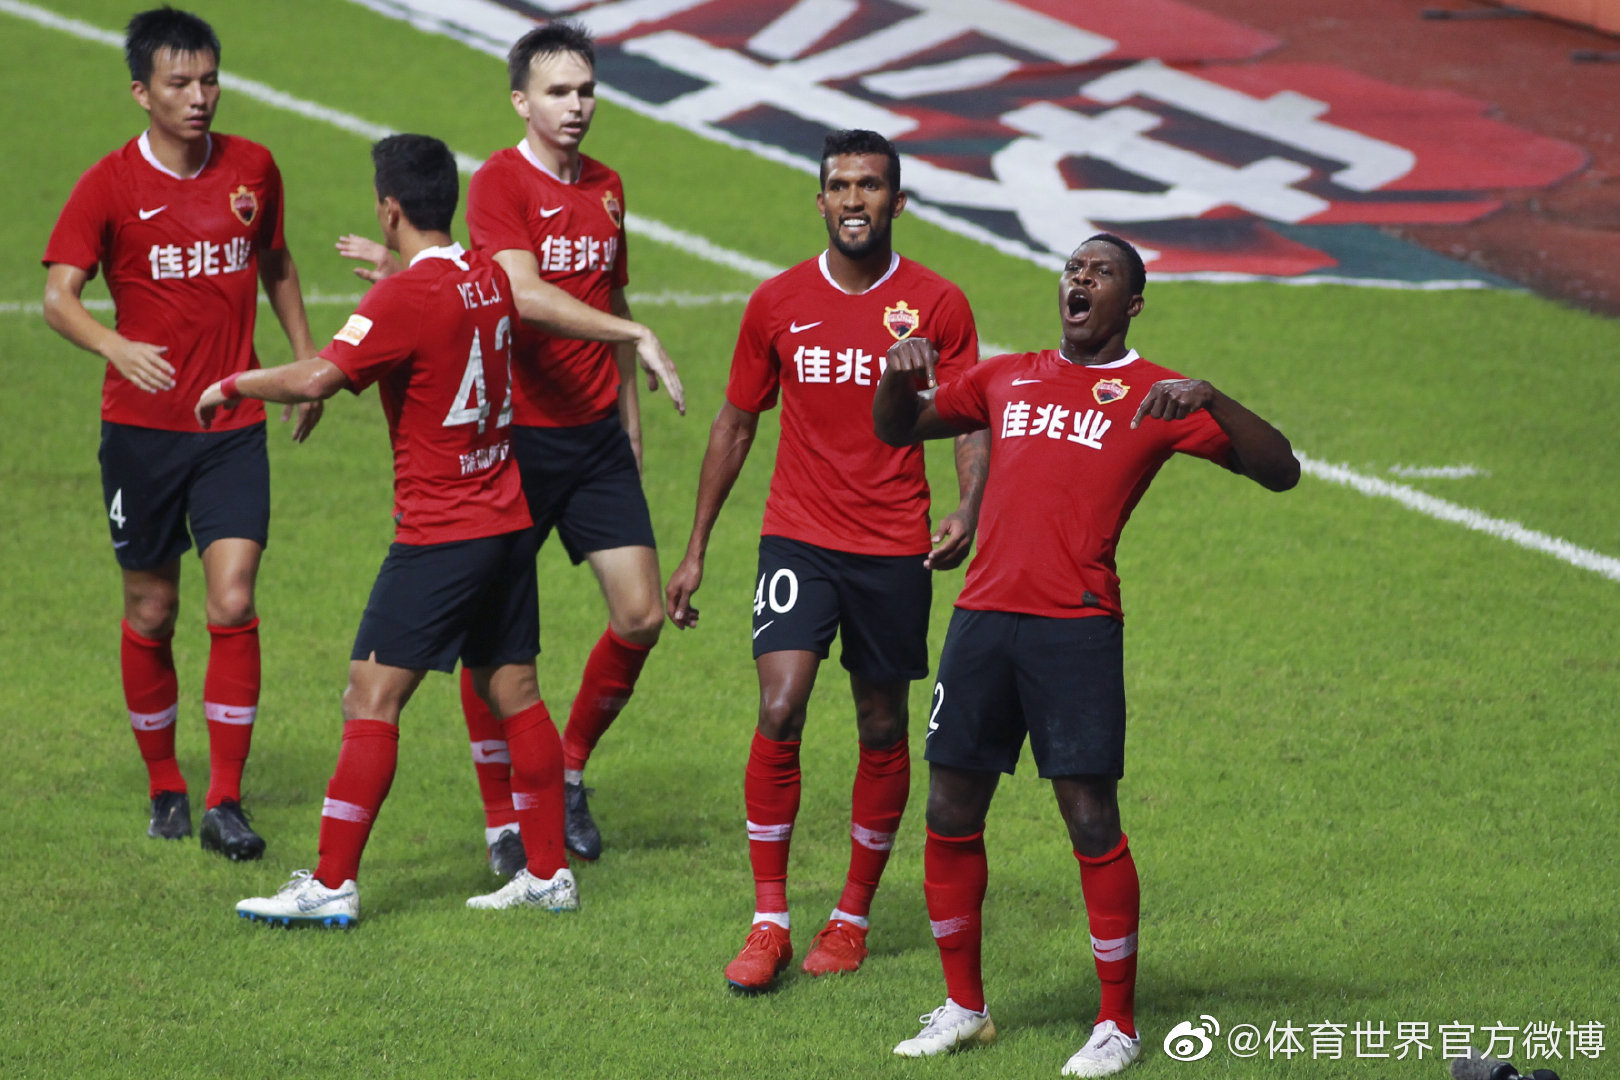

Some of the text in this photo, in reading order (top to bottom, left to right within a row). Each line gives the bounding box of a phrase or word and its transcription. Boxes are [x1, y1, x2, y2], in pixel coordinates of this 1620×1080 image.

[400, 0, 1416, 262] 平安
[149, 236, 250, 280] 佳兆业
[456, 282, 478, 310] YE
[793, 345, 888, 387] 佳兆
[1001, 401, 1112, 450] 佳兆业
[109, 487, 126, 529] 4
[753, 568, 799, 616] 40
[929, 681, 945, 730] 2
